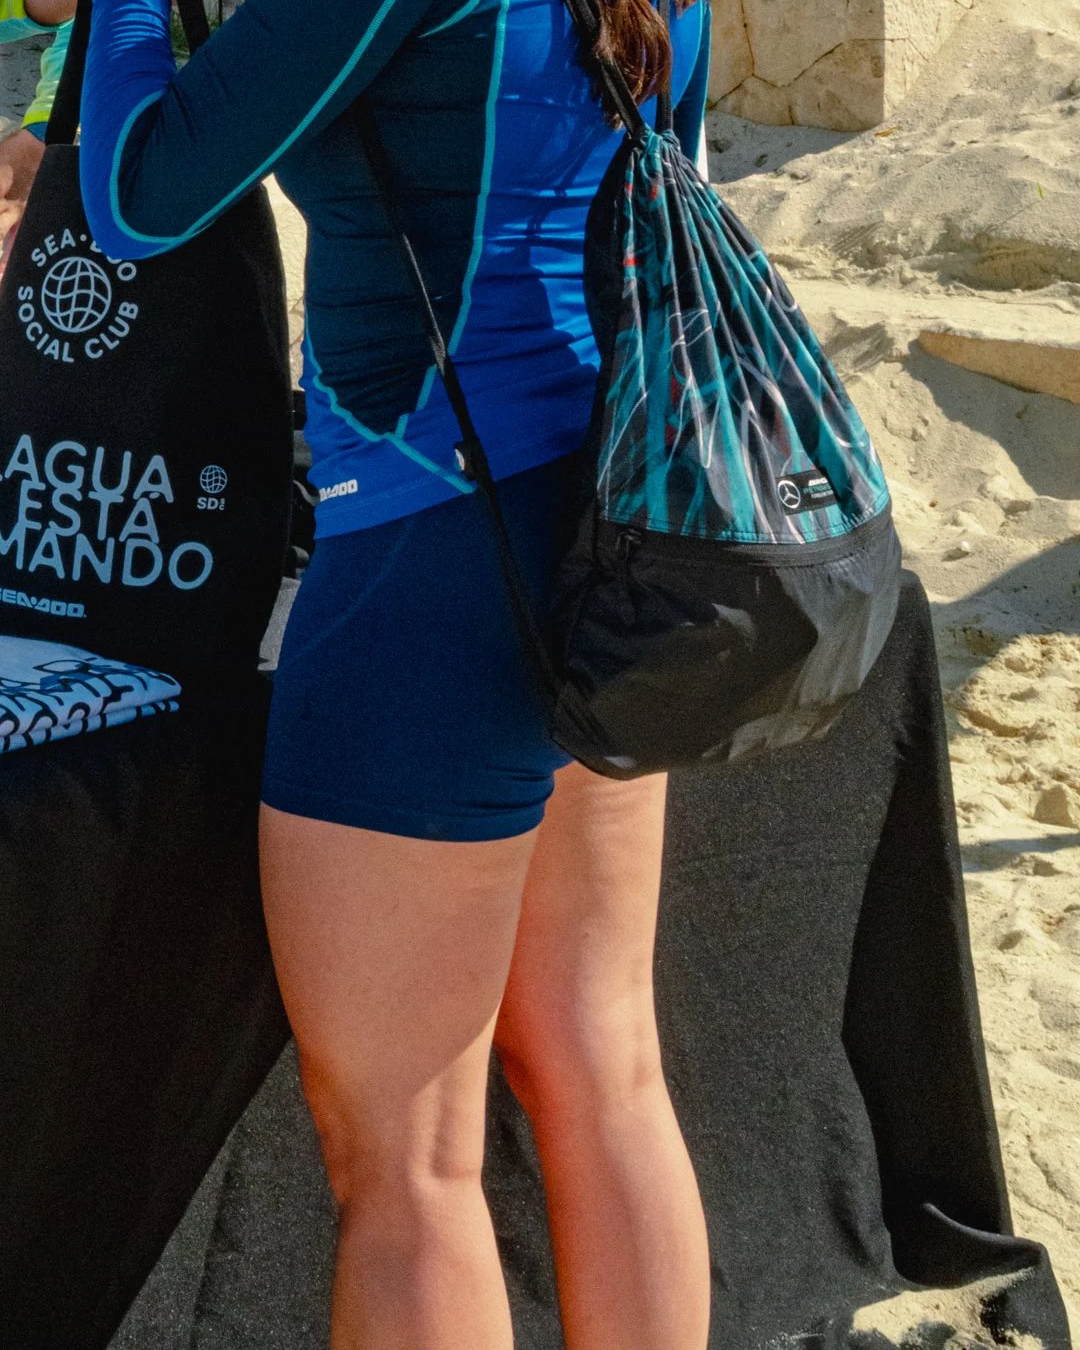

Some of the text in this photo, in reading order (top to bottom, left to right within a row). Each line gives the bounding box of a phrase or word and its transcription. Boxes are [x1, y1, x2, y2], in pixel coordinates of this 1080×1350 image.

[17, 285, 139, 363] SOCIAL CLUB
[3, 434, 174, 504] AGUA
